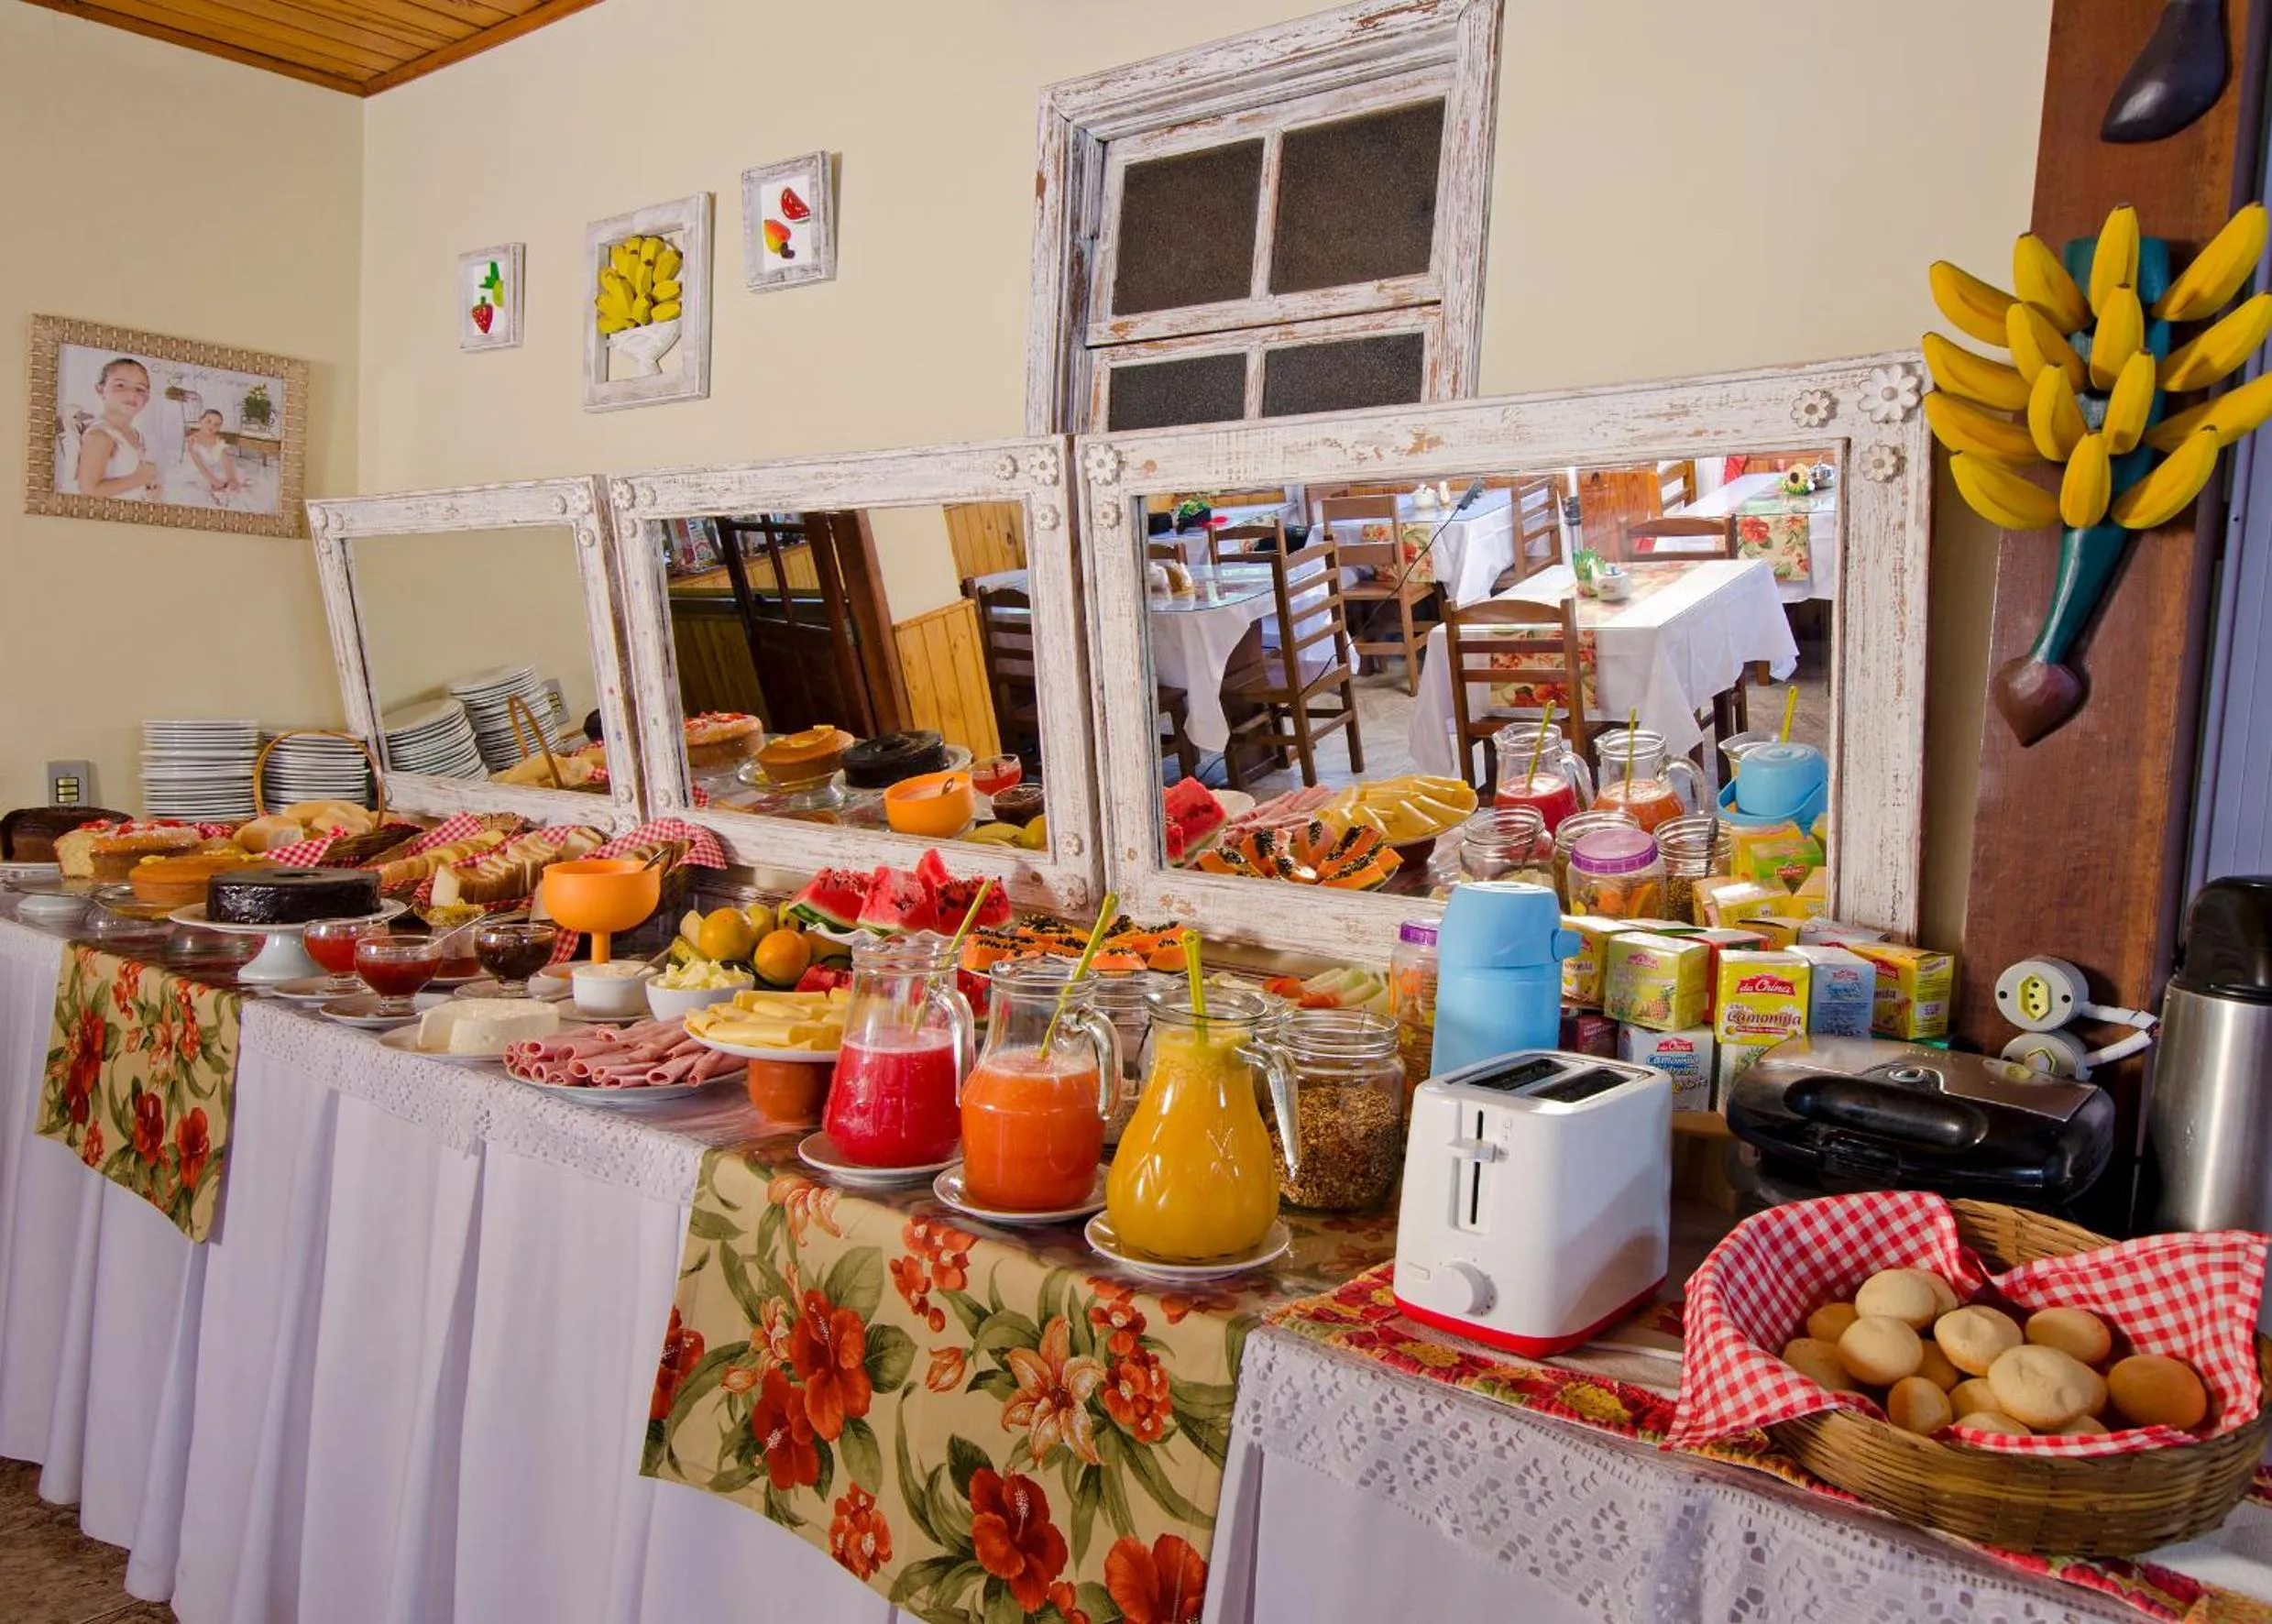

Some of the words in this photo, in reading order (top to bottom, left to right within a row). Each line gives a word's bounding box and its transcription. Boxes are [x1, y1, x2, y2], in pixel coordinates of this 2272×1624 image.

[1740, 983, 1753, 993] da
[1754, 979, 1792, 994] China
[1727, 1011, 1802, 1026] Camomila
